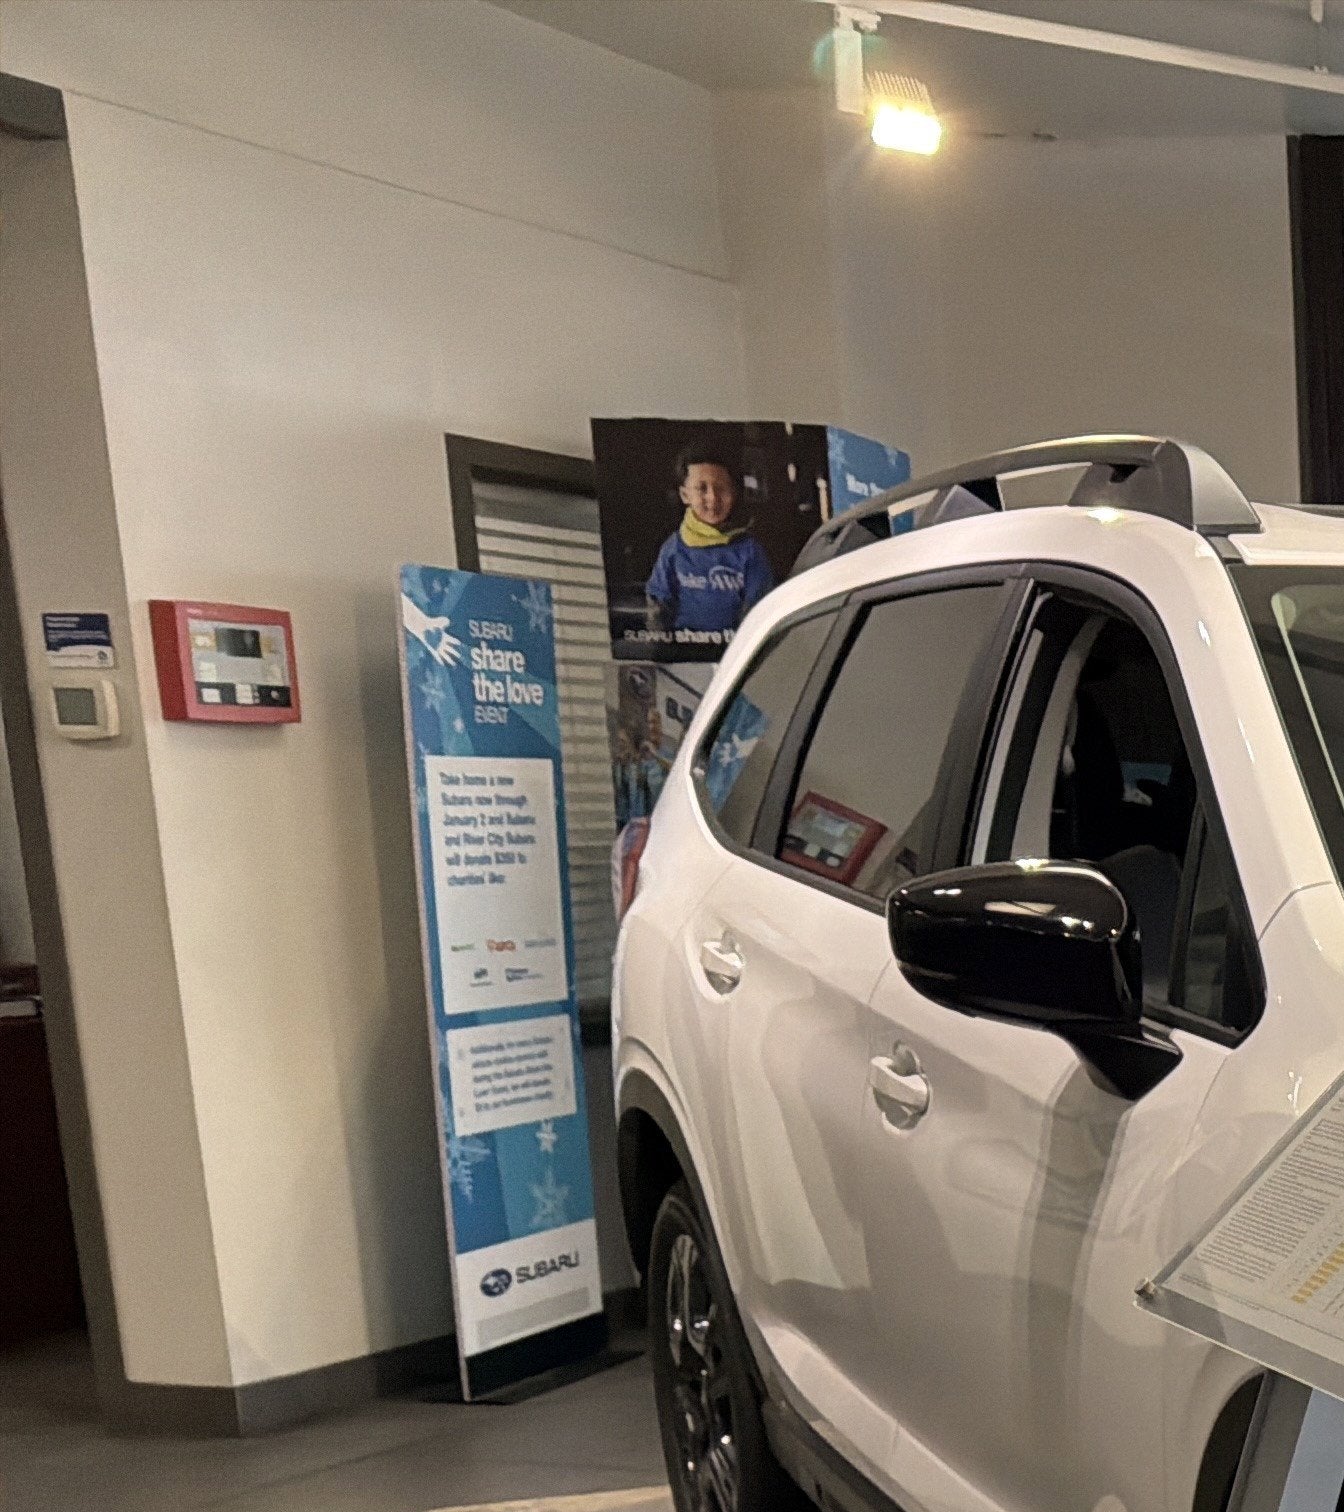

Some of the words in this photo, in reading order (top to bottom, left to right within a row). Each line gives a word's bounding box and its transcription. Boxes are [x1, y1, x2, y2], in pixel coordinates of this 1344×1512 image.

[468, 619, 513, 642] SUBARU
[675, 627, 722, 644] share
[723, 628, 737, 644] th
[470, 640, 526, 673] share
[472, 672, 504, 703] the
[505, 674, 545, 706] love
[474, 705, 509, 724] EVENT
[515, 1251, 580, 1285] SUBARU
